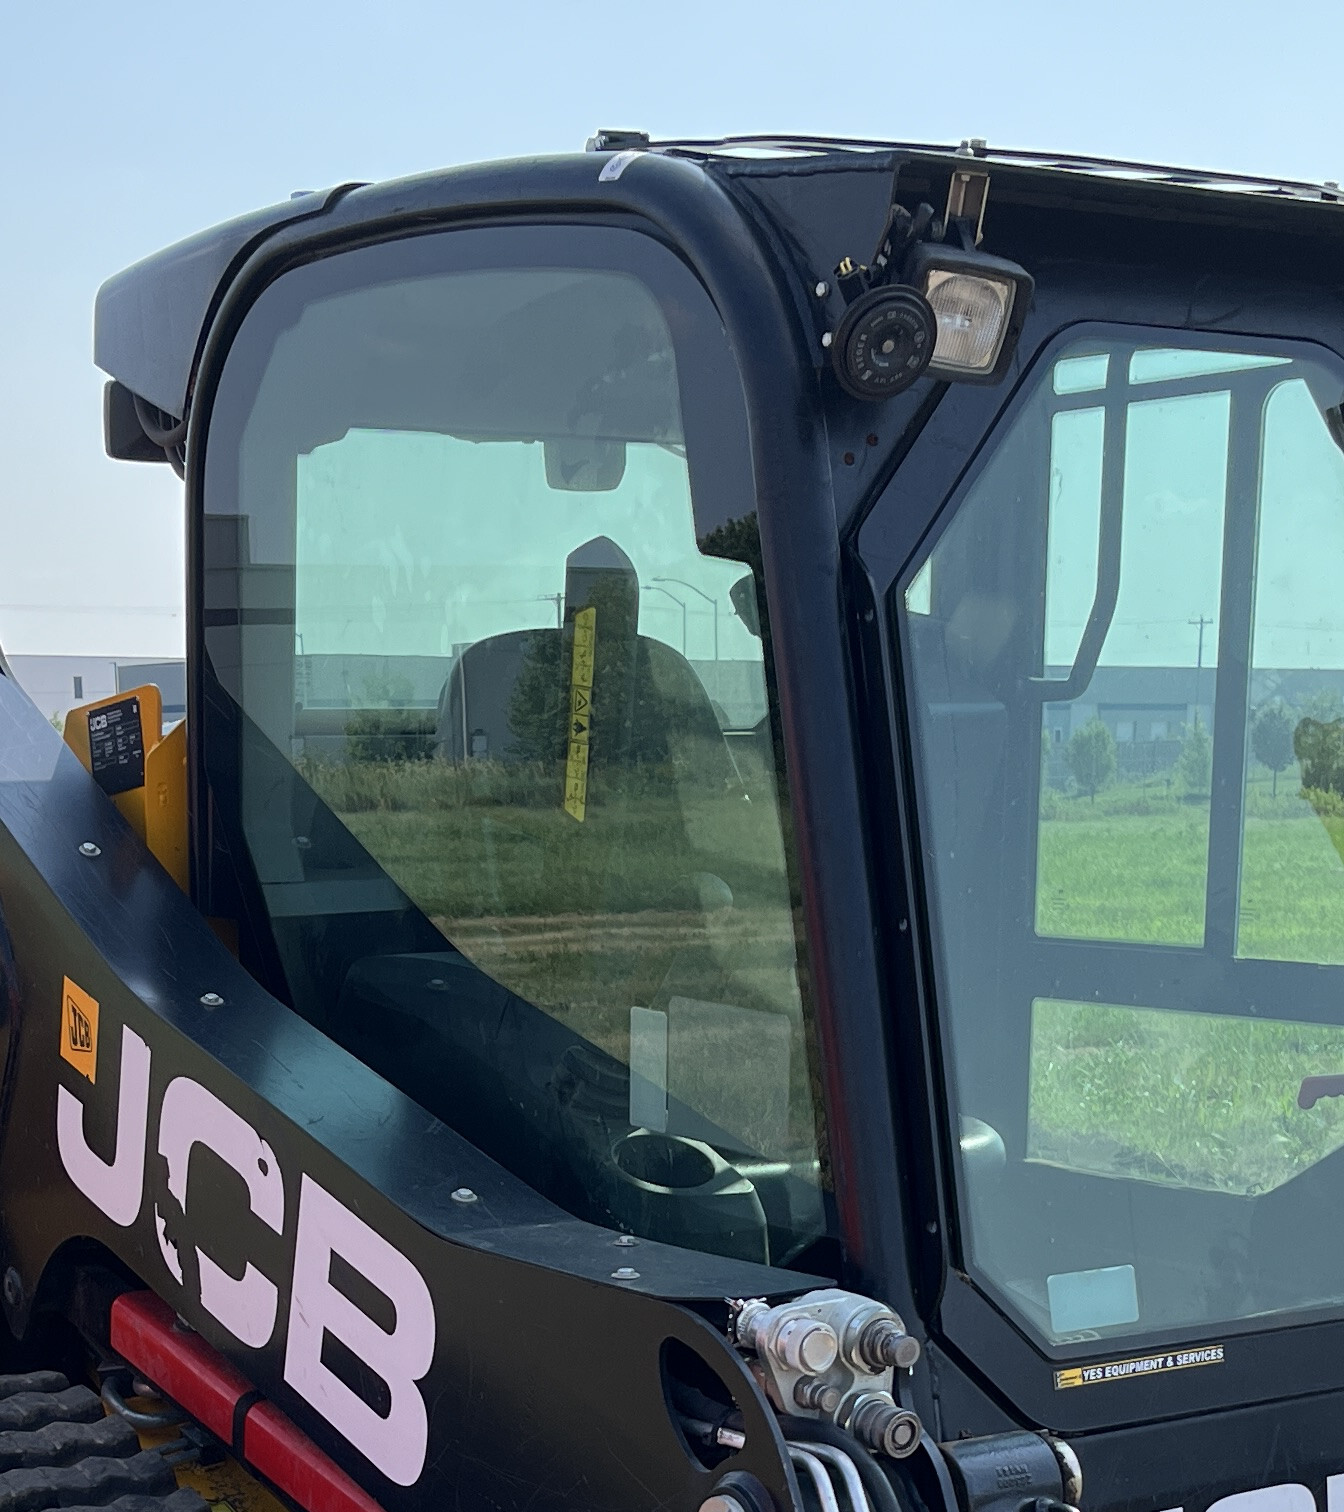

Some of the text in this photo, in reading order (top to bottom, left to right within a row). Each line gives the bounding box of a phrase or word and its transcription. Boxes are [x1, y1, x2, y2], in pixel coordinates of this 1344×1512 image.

[69, 1004, 91, 1050] JCB
[57, 1024, 436, 1487] JCB
[1083, 1367, 1104, 1381] YES
[1105, 1357, 1164, 1378] EQUIPMENT
[1166, 1356, 1174, 1368] &
[1176, 1348, 1224, 1366] SERVICES
